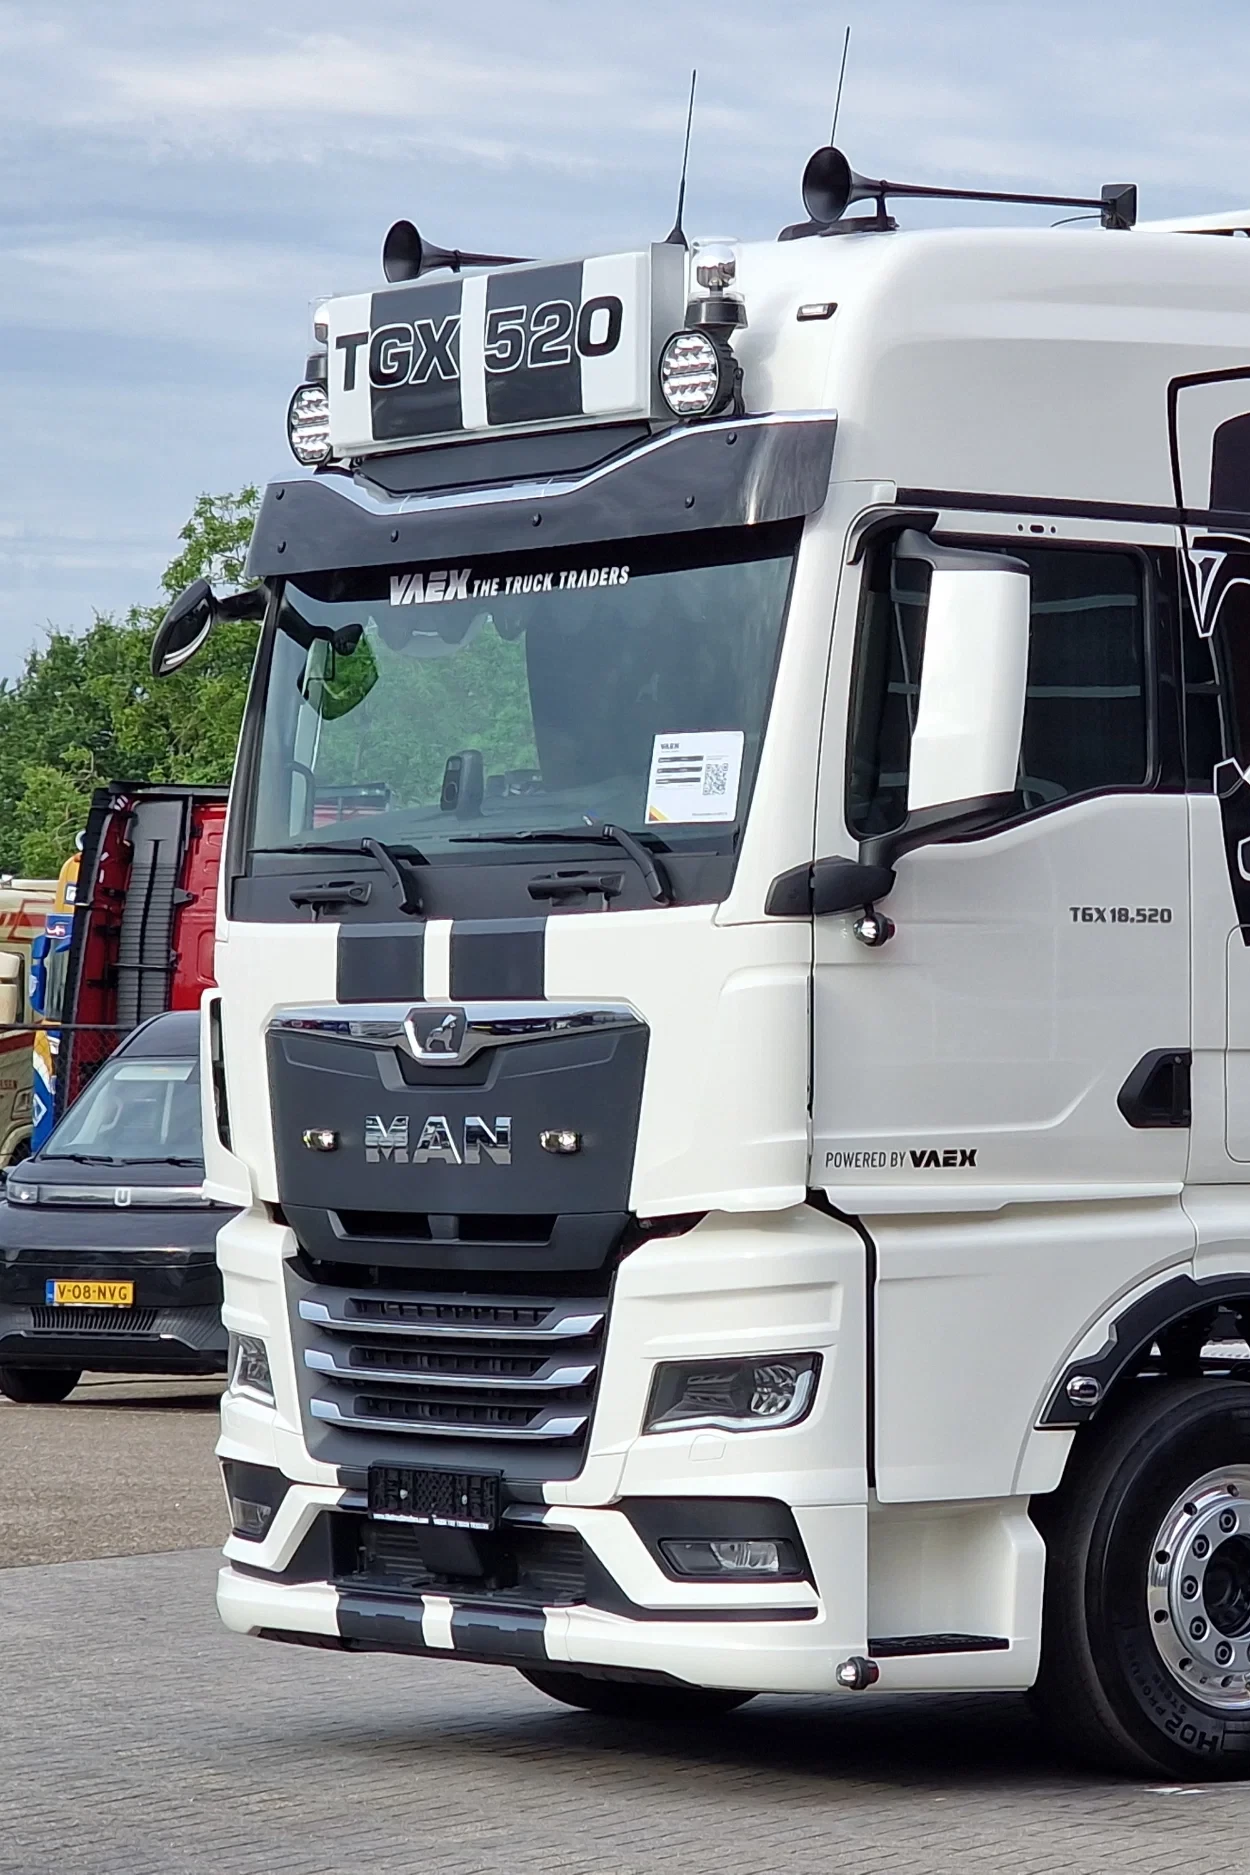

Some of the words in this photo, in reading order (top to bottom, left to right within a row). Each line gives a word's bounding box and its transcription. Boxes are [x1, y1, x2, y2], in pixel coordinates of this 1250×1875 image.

[335, 315, 461, 391] TGX
[485, 295, 623, 373] 520
[390, 568, 472, 606] VAEX
[473, 578, 500, 598] THE
[504, 572, 554, 595] TRUCK
[559, 566, 630, 590] TRADERS
[364, 1115, 512, 1165] MAN
[825, 1151, 887, 1168] POWERED
[890, 1151, 906, 1168] BY
[909, 1149, 977, 1168] VAEX
[57, 1284, 127, 1301] V-08-NVG
